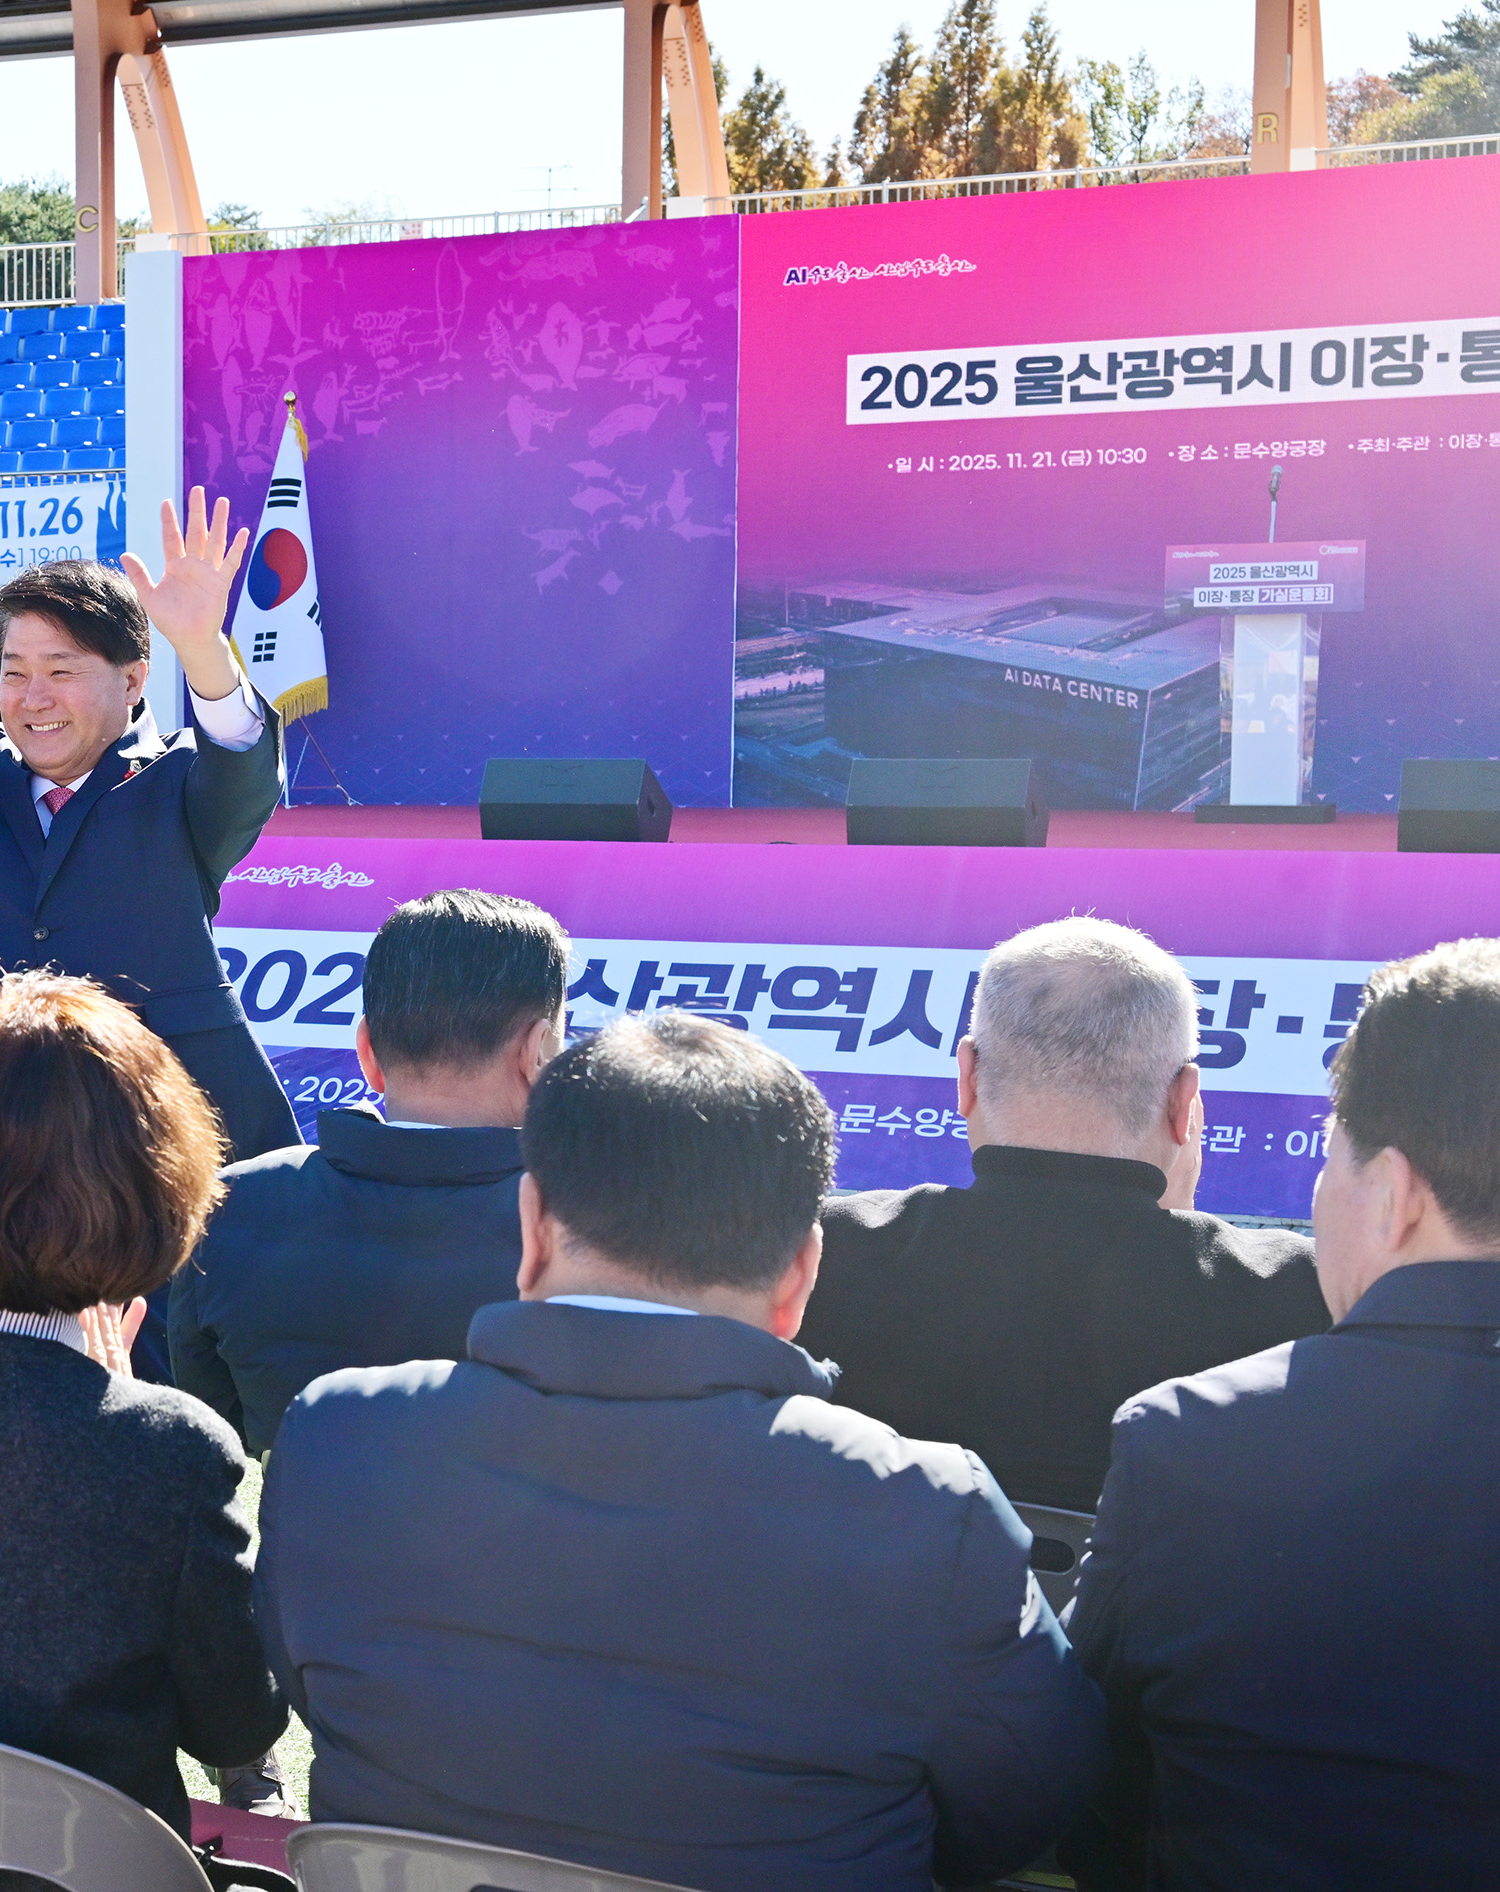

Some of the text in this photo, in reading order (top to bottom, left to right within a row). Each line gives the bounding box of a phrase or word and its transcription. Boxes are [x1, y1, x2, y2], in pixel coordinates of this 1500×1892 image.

[1257, 112, 1278, 144] R
[76, 205, 98, 232] C
[860, 360, 998, 410] 2025
[1014, 342, 1292, 406] 울산광역시
[1233, 439, 1327, 460] 문수양궁장
[1357, 435, 1431, 453] 주최·주관
[949, 454, 1001, 471] 2025.
[1006, 453, 1027, 469] 11.
[1032, 452, 1057, 468] 21.
[1061, 450, 1092, 467] (금)
[1096, 448, 1147, 465] 10:30
[30, 545, 82, 564] 19:00
[1213, 564, 1314, 579] 2025 울산광역시
[1004, 668, 1139, 709] AI DATA CENTER
